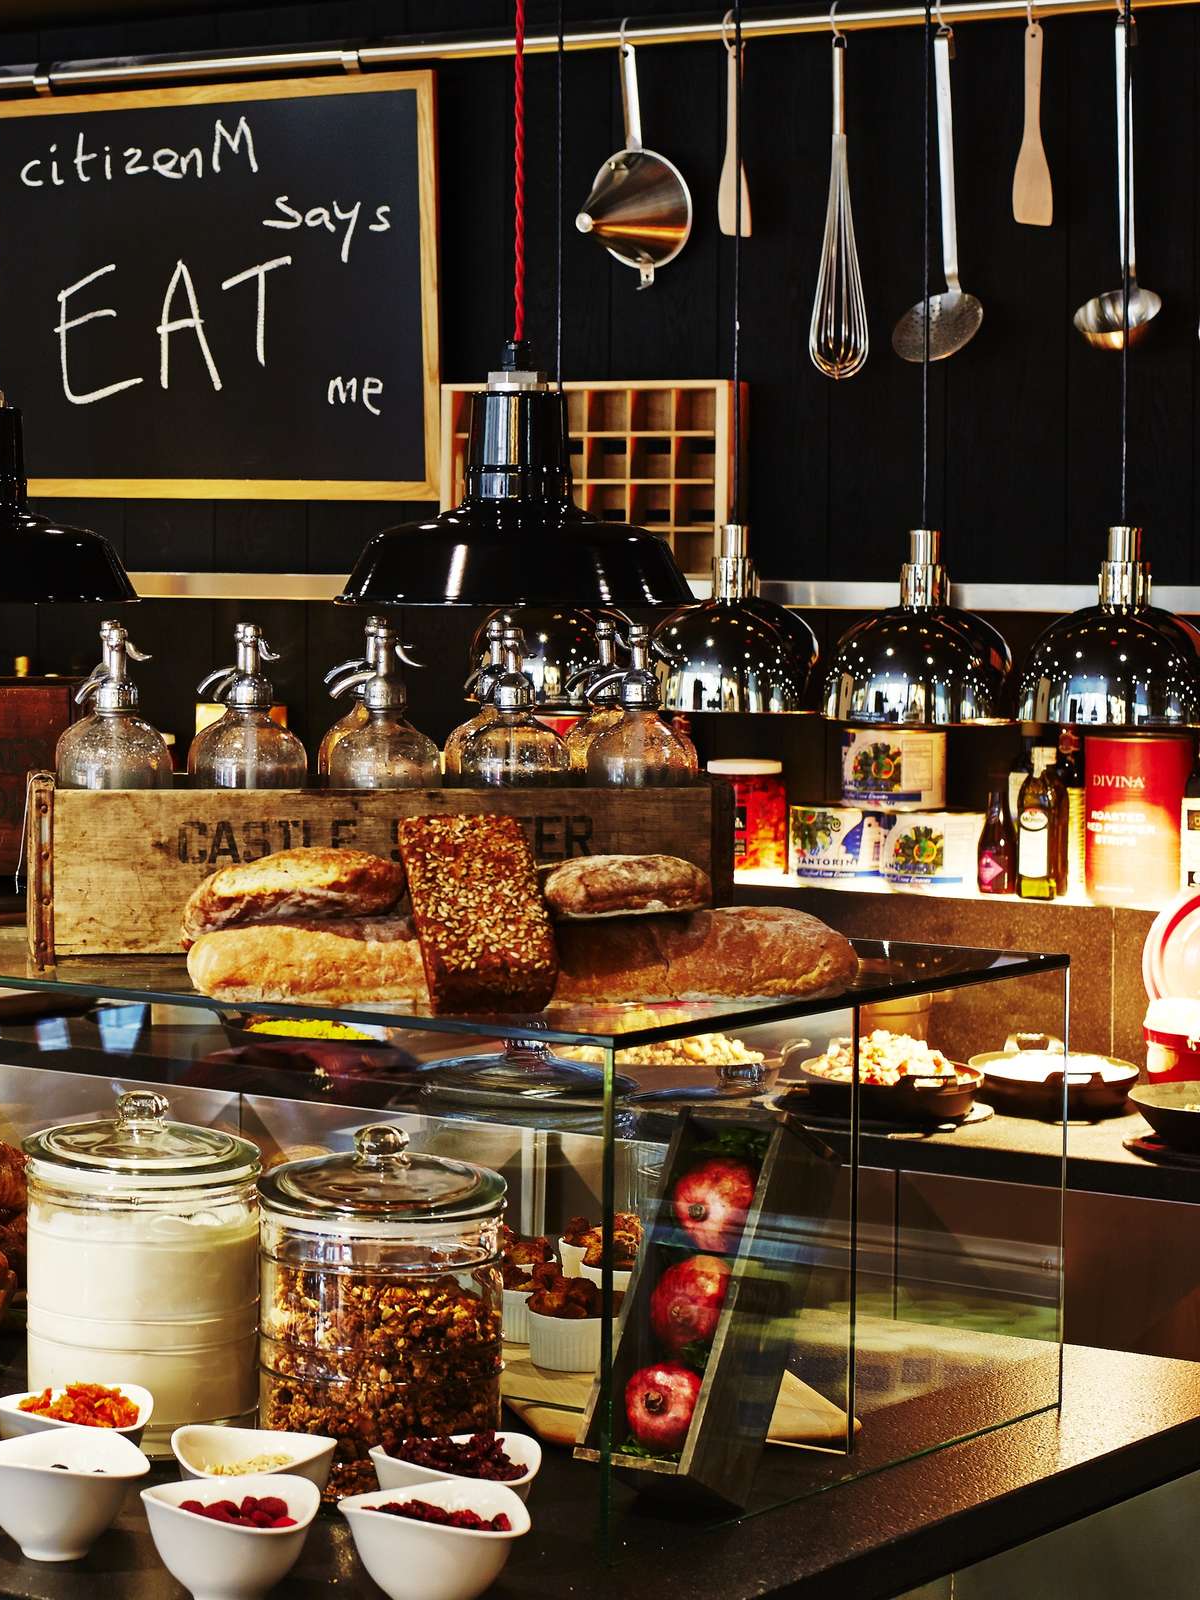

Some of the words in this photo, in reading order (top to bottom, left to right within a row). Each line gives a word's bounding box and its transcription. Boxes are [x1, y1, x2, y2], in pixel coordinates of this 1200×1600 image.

[20, 116, 259, 188] citizenM
[54, 255, 292, 405] EAT
[328, 376, 384, 416] me
[1092, 774, 1146, 789] DIVINA
